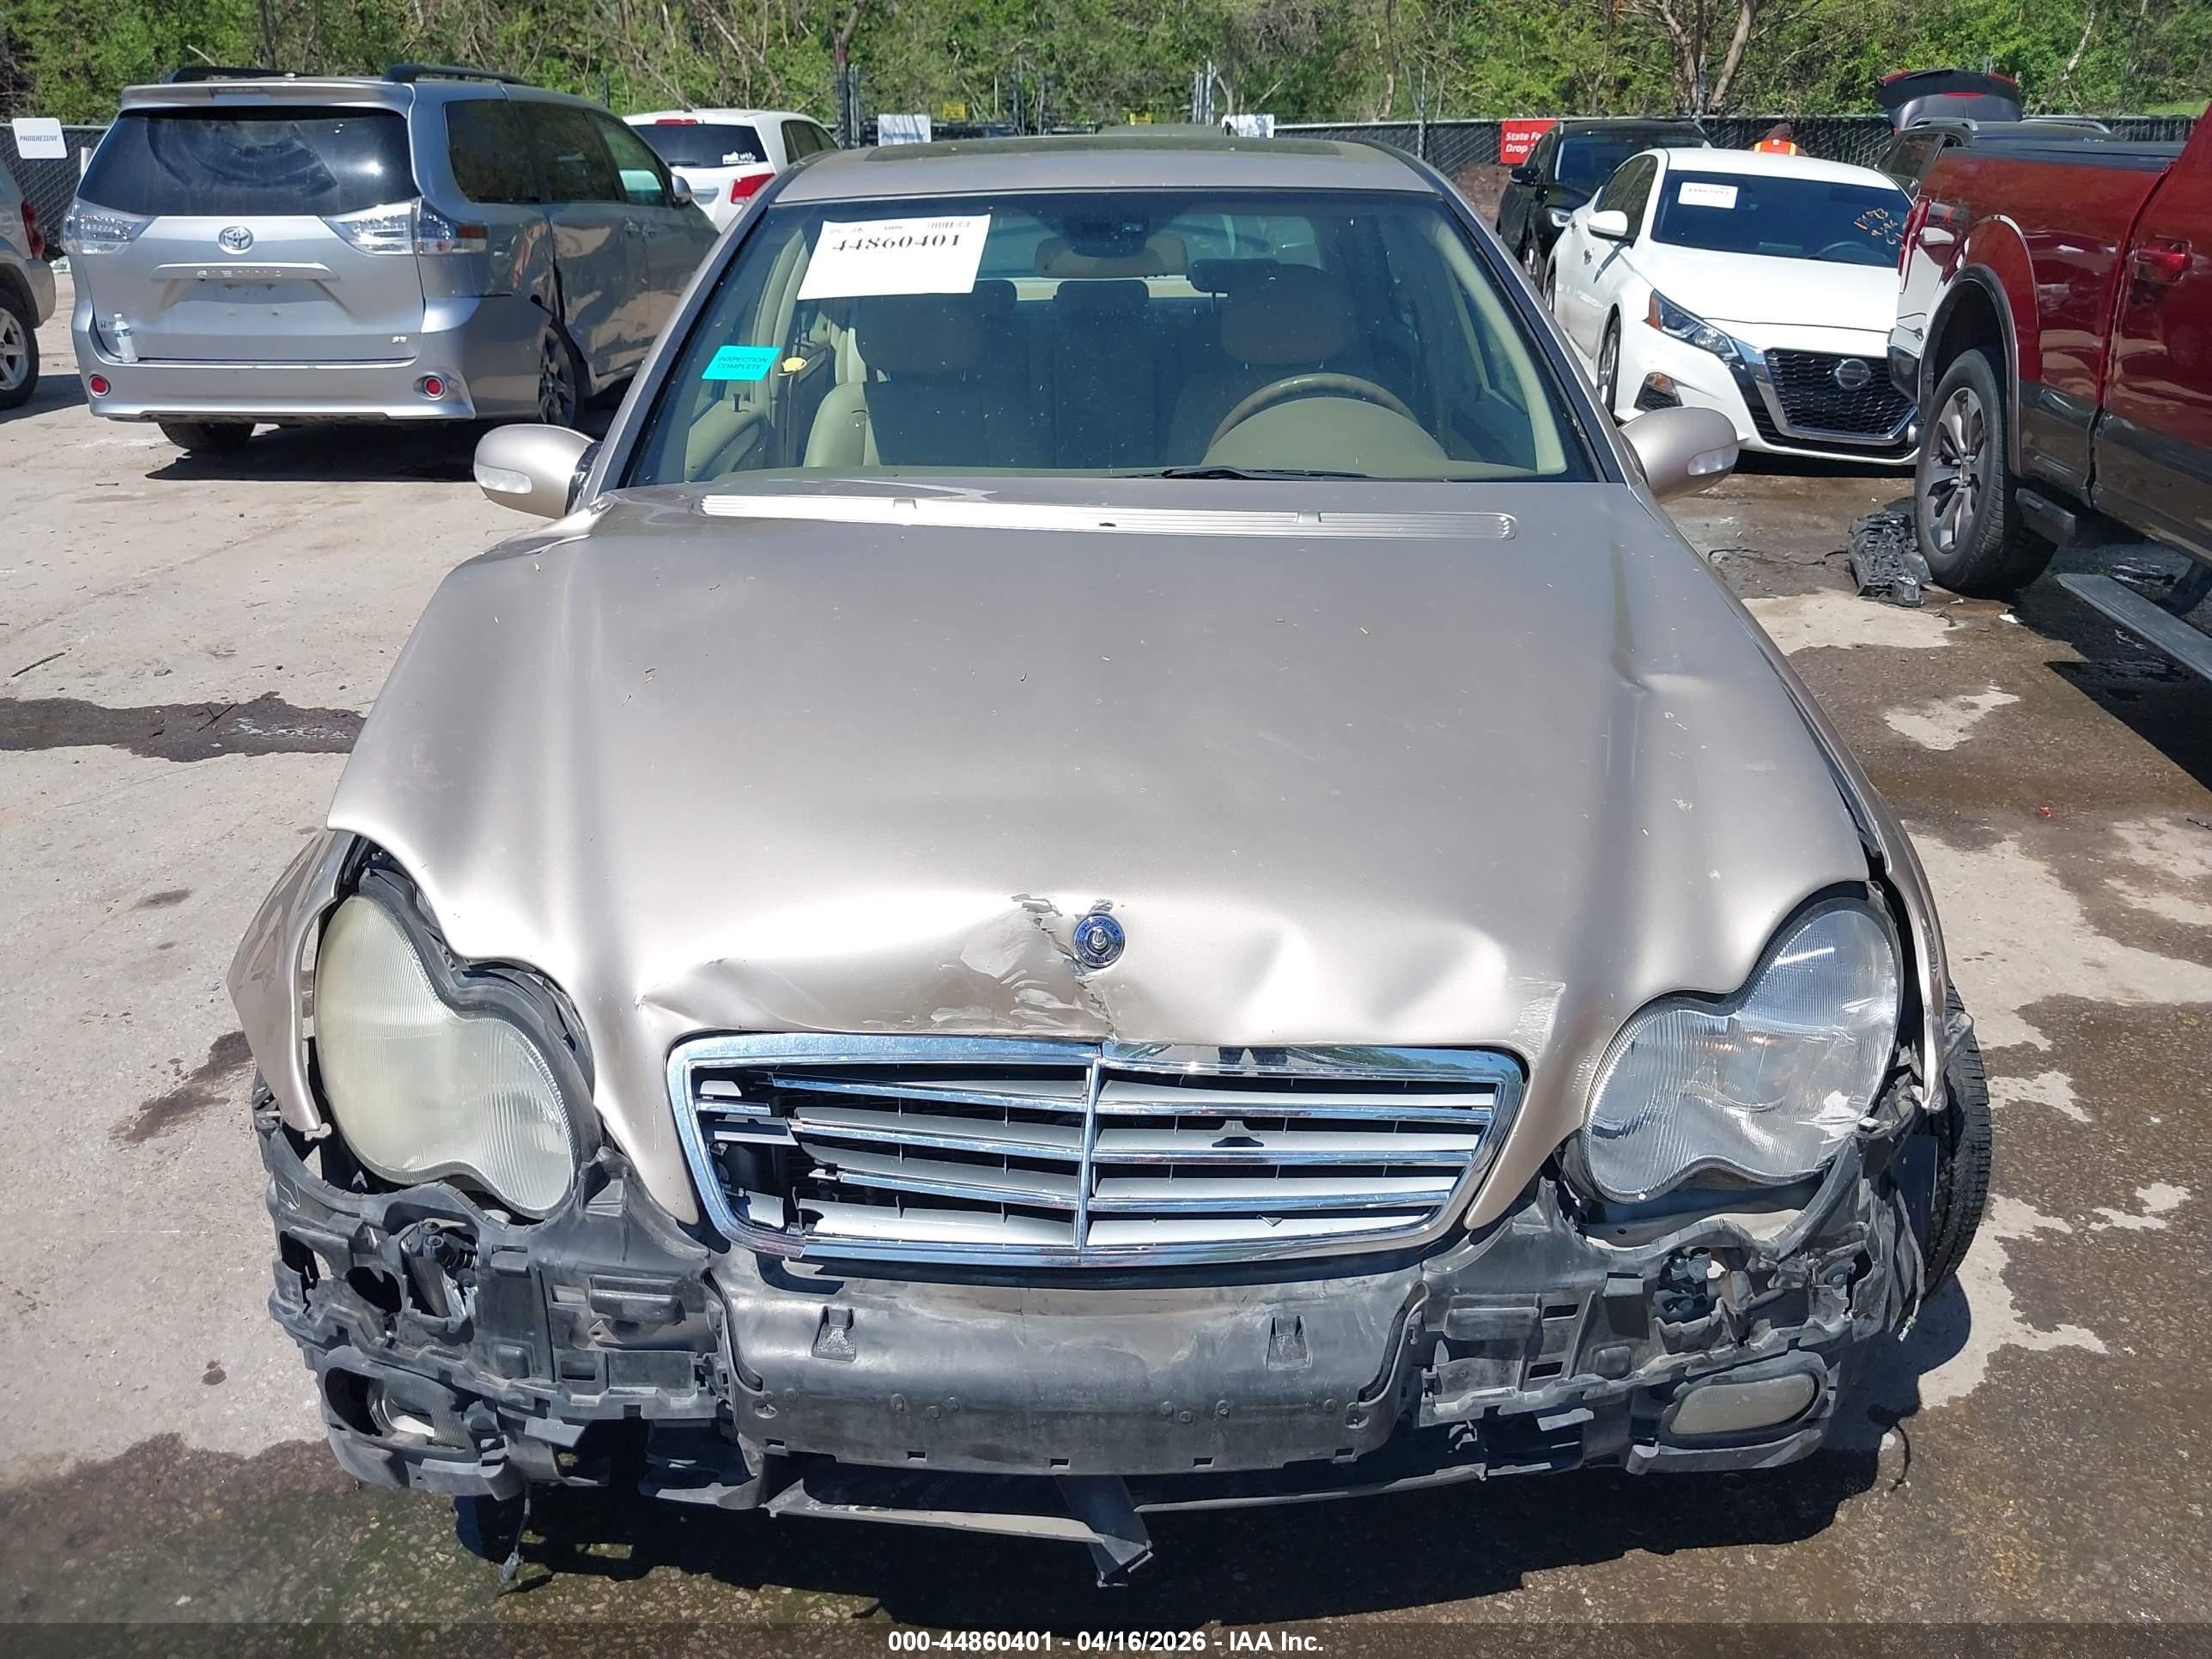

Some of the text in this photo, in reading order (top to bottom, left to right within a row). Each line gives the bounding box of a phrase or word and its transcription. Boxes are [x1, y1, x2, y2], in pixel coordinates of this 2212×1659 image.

[1505, 132, 1529, 141] State
[1505, 143, 1528, 155] Drop
[831, 233, 961, 252] 44860401
